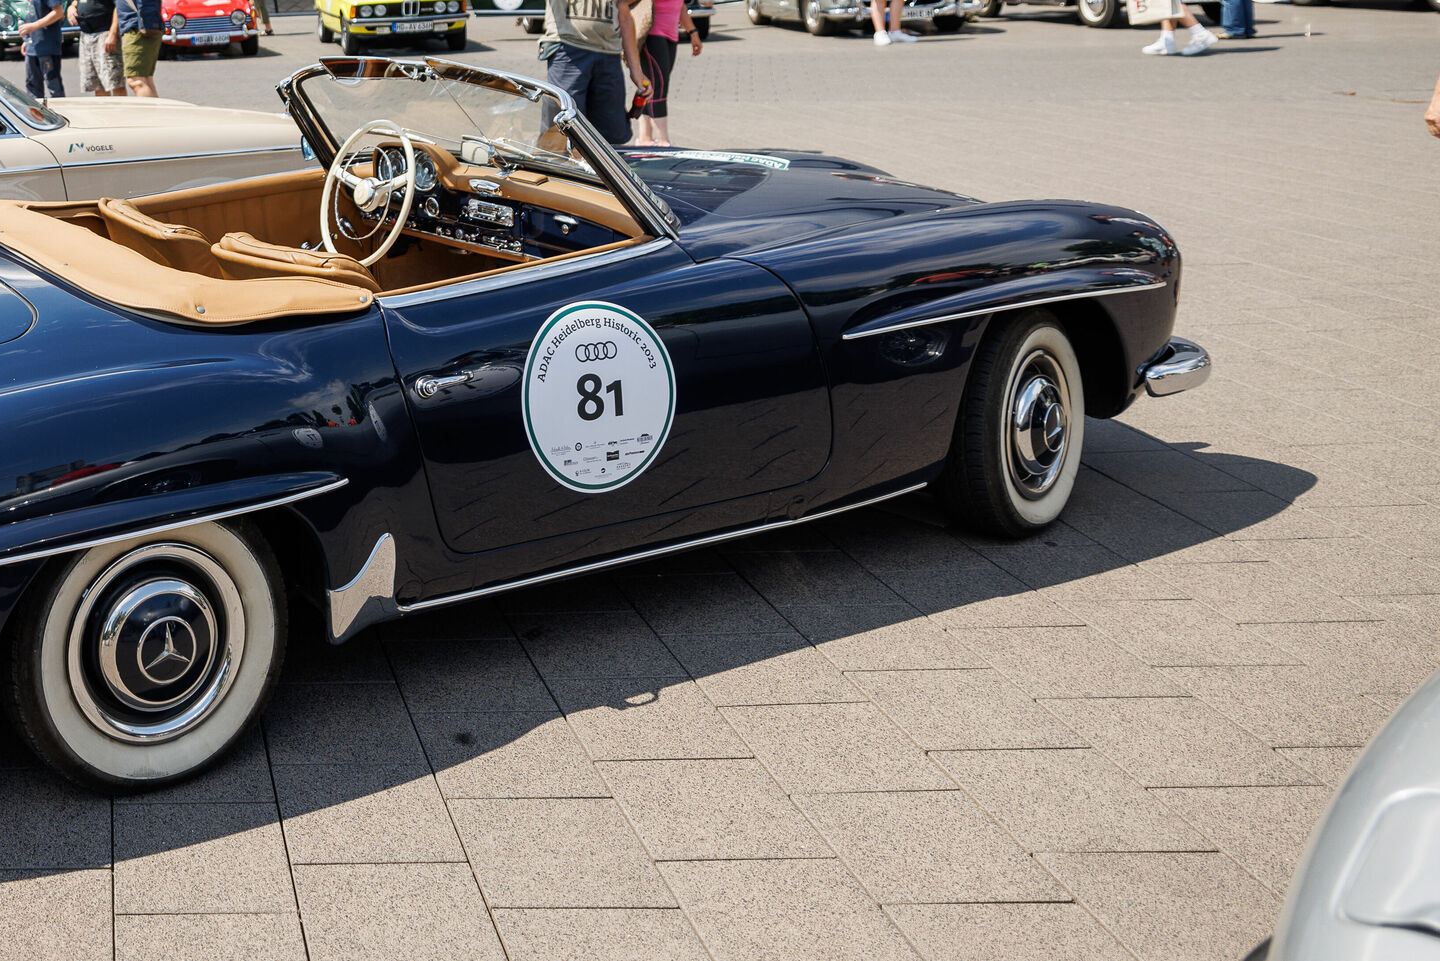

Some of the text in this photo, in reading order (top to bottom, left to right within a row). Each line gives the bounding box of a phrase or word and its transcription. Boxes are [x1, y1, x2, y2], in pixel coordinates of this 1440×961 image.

[537, 317, 657, 383] ADAC Heidelberg Historic 2023
[576, 373, 624, 421] 81
